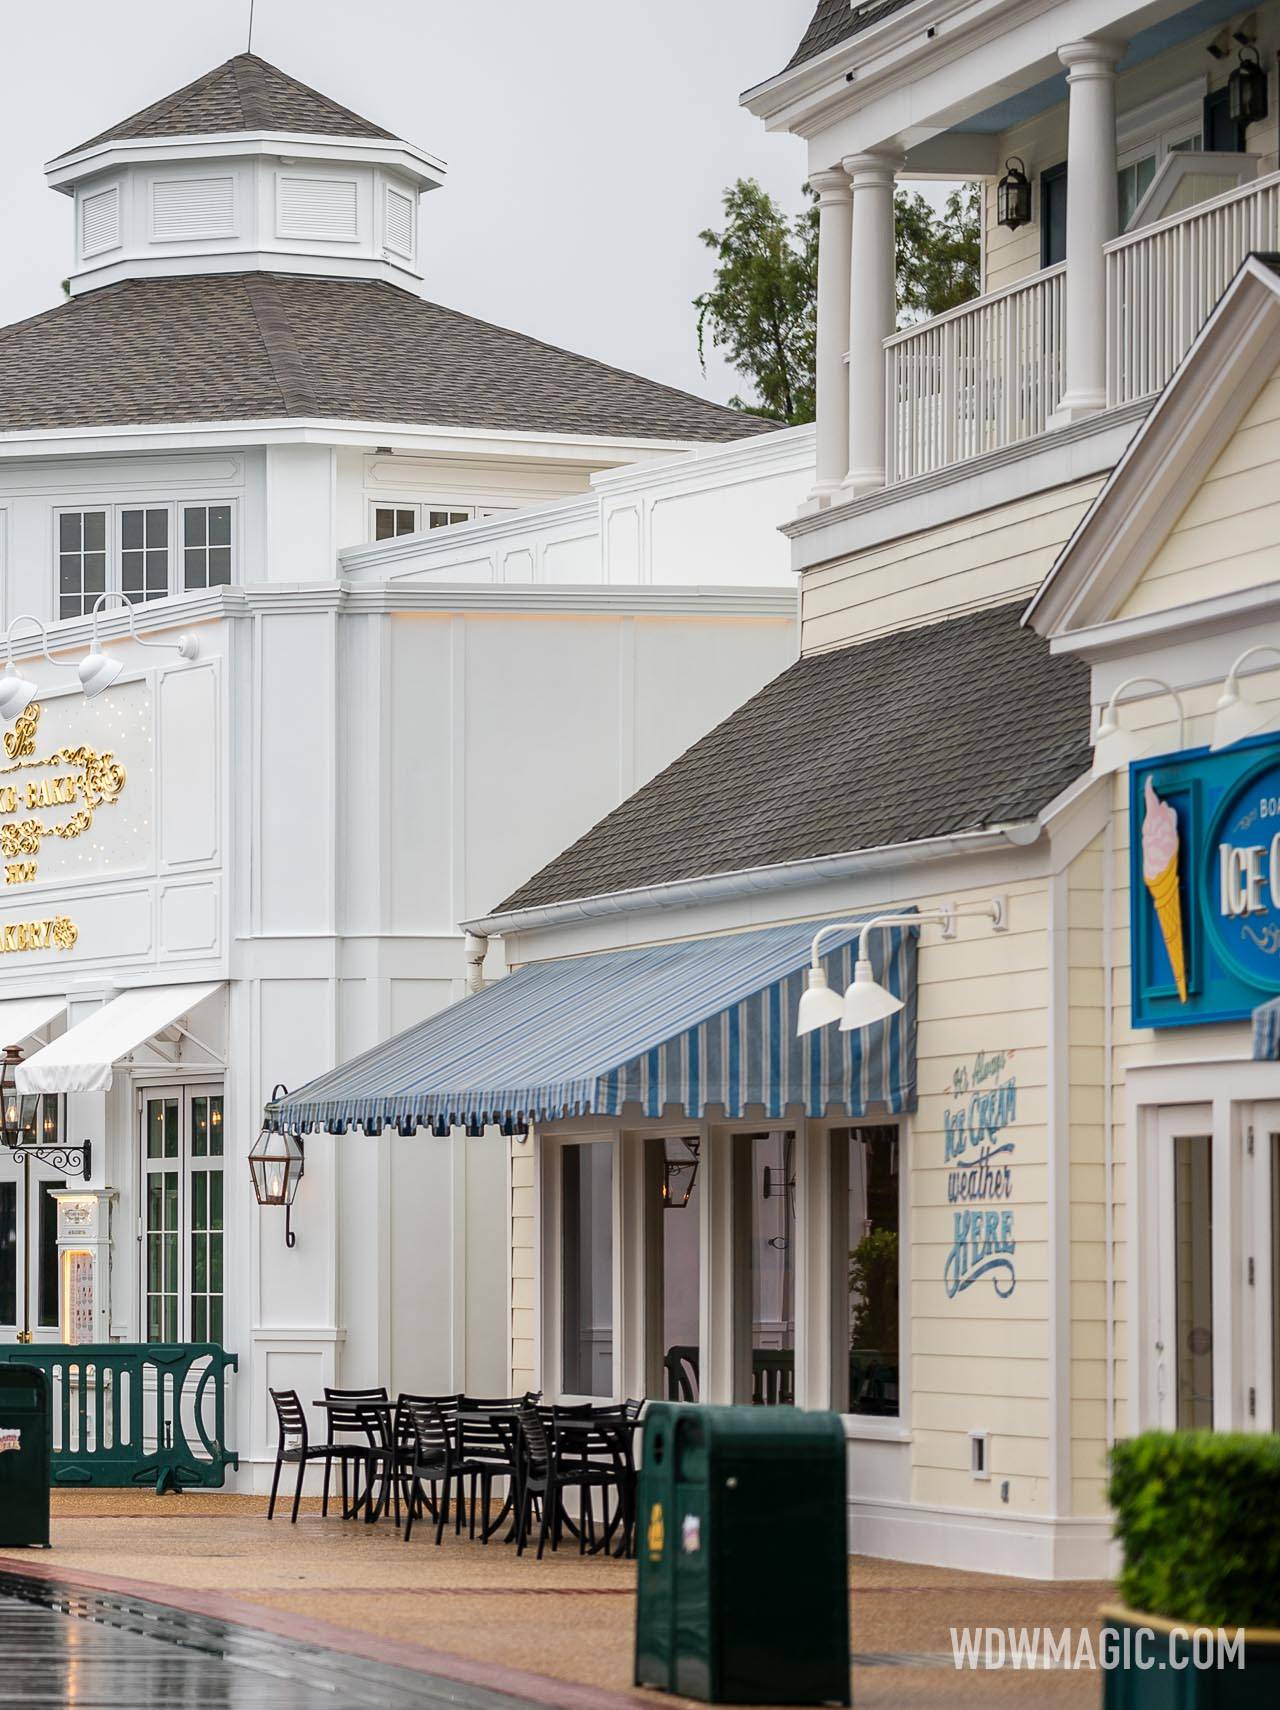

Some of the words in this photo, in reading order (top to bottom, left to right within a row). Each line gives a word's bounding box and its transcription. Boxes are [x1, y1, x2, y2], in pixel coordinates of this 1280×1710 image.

[25, 775, 77, 810] BAKE
[1219, 842, 1268, 918] ICE
[944, 1108, 967, 1163] ICE
[967, 1074, 1016, 1146] CREAM
[947, 1144, 1014, 1203] weather
[944, 1209, 1016, 1298] HERE
